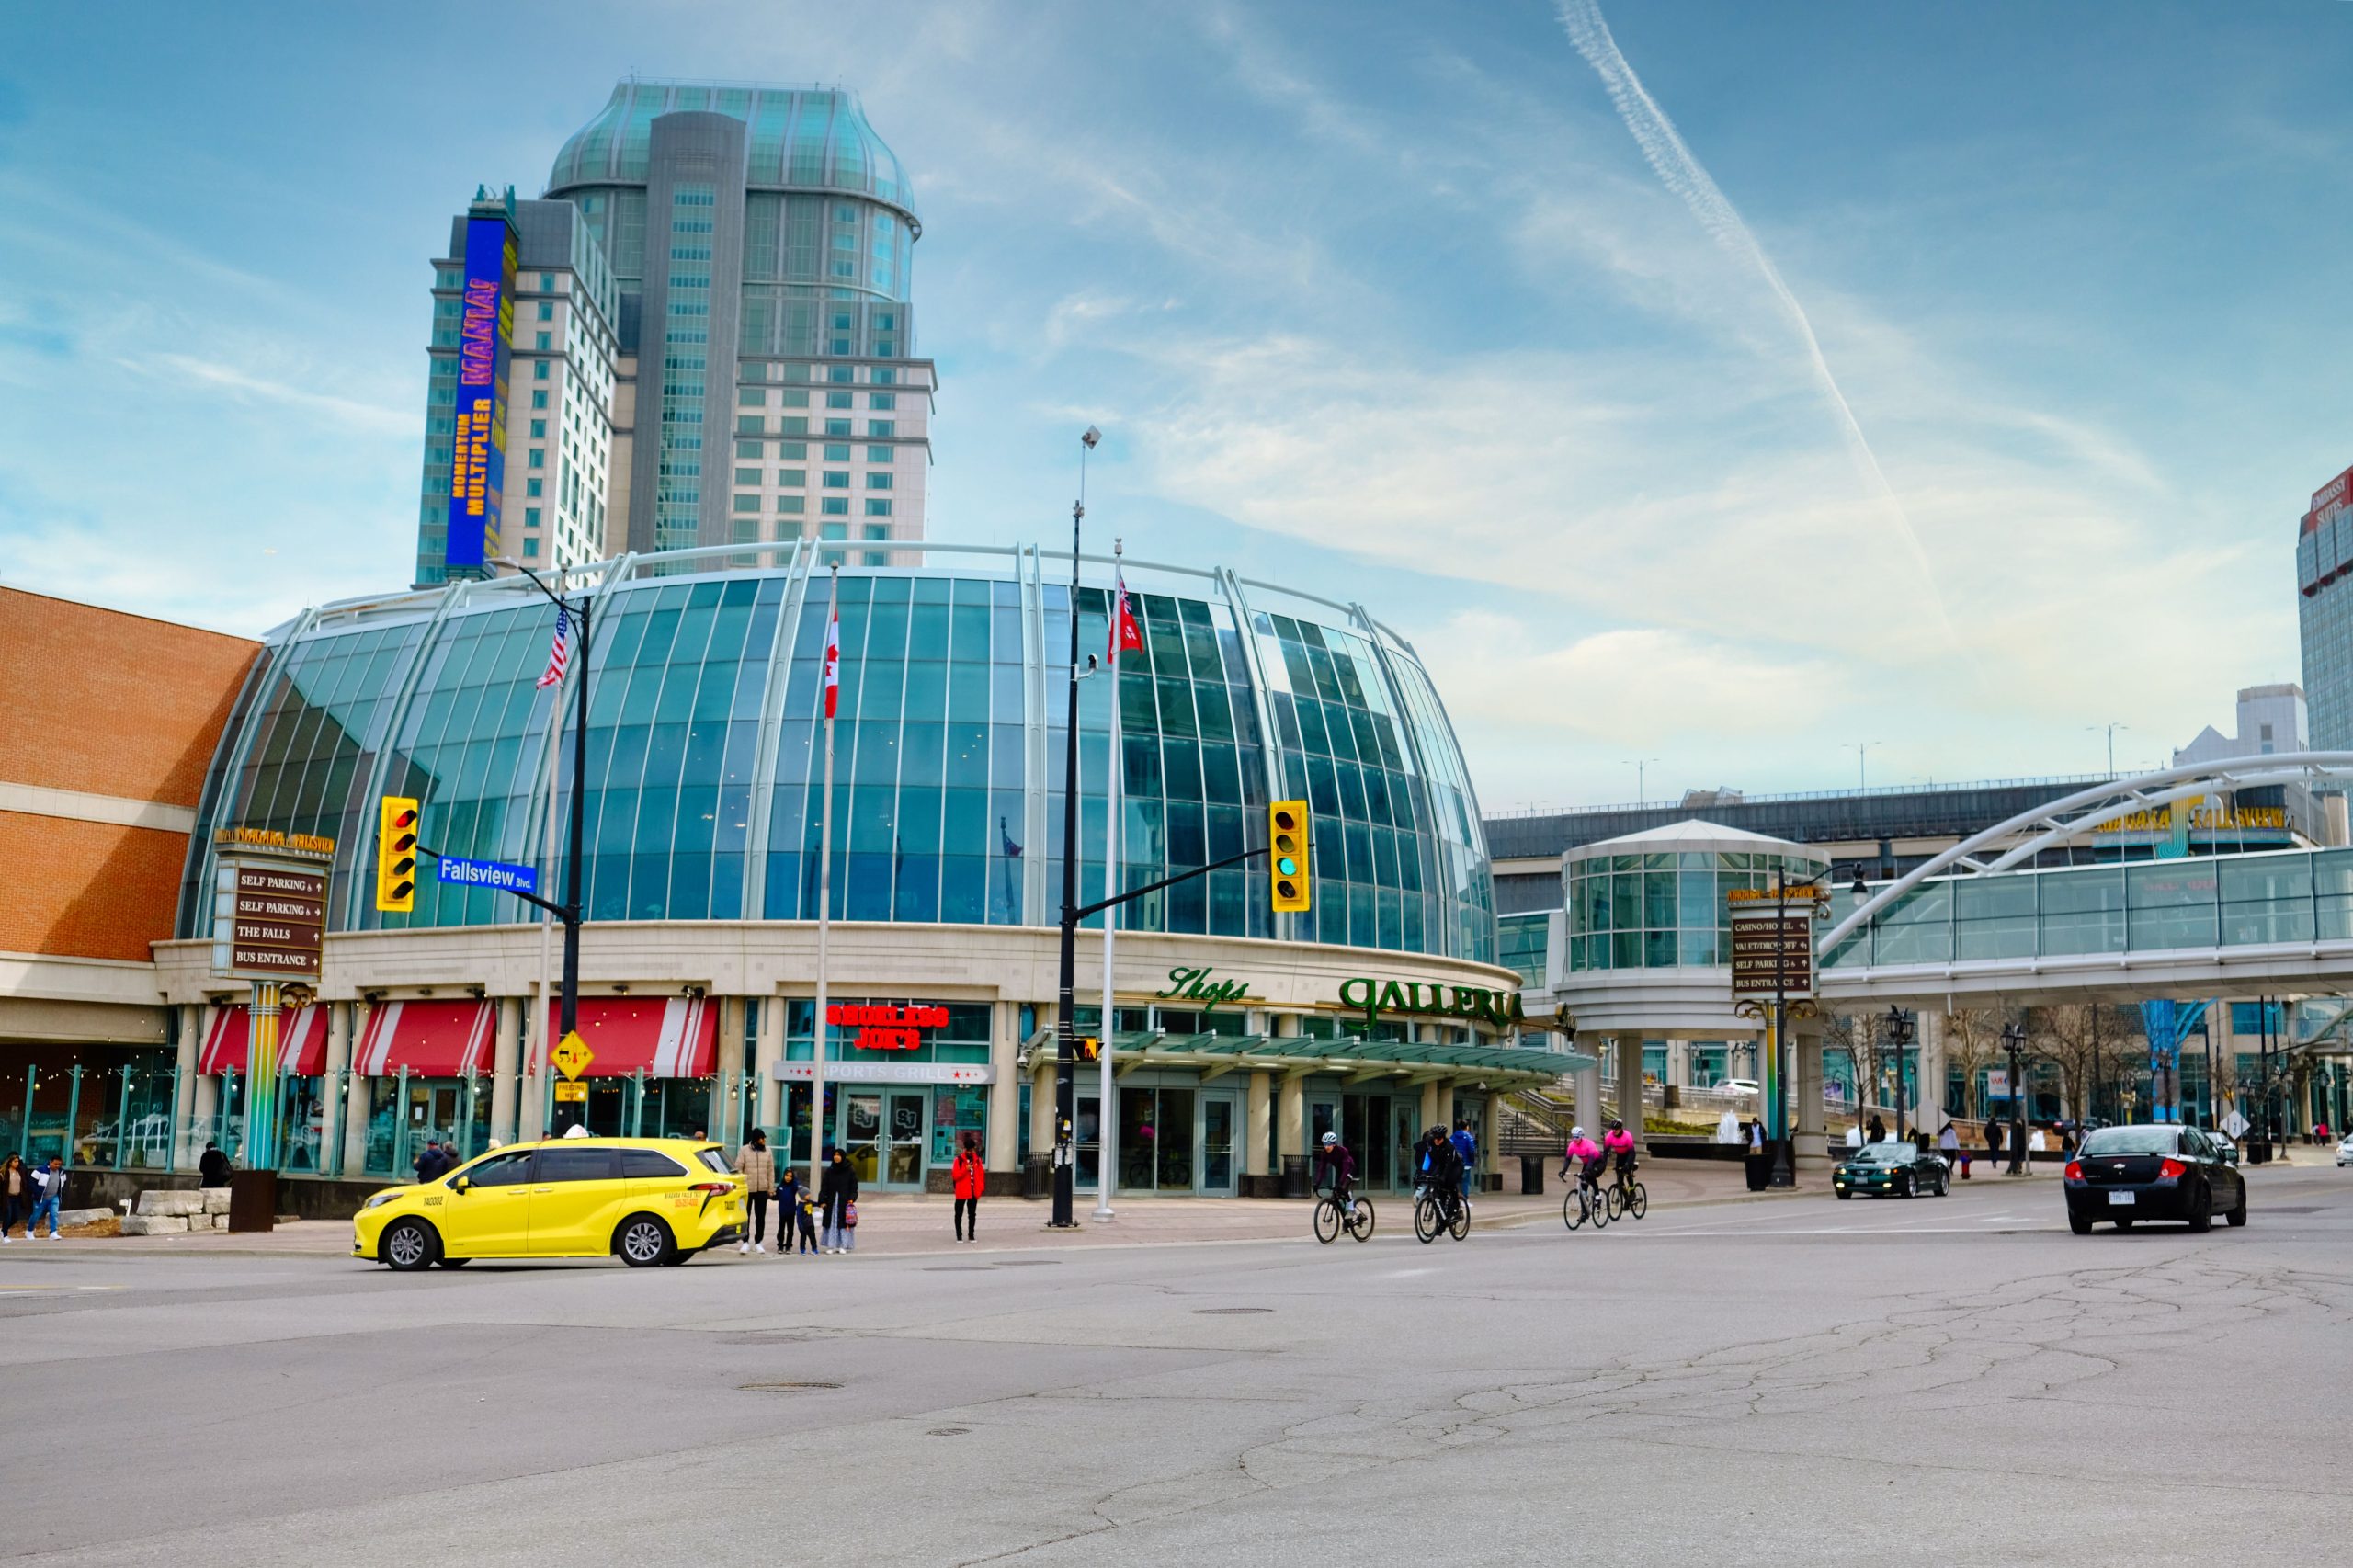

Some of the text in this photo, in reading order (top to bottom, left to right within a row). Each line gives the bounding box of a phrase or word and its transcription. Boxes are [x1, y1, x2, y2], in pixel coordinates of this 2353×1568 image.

[461, 278, 499, 385] MANIA!
[452, 414, 471, 498] MOMENTUM
[466, 398, 491, 516] MULTIPLIER
[2313, 478, 2346, 510] EMBASSY
[241, 874, 306, 891] SELF PARKING
[441, 858, 532, 889] Fallsview Blvd.
[239, 900, 304, 915] SELF PARKING
[237, 926, 290, 939] THE FALLS
[1734, 922, 1794, 932] CASINO/HOEL
[236, 951, 306, 966] BUS ENTRANCE
[1735, 959, 1790, 970] SELF PARKIG
[1156, 966, 1249, 1013] Shops
[1735, 978, 1795, 988] BUS ENTRACE
[825, 1005, 949, 1028] SHOELESS
[853, 1027, 921, 1050] JOE'S
[893, 1065, 946, 1080] GRILL
[896, 1109, 916, 1128] SJ
